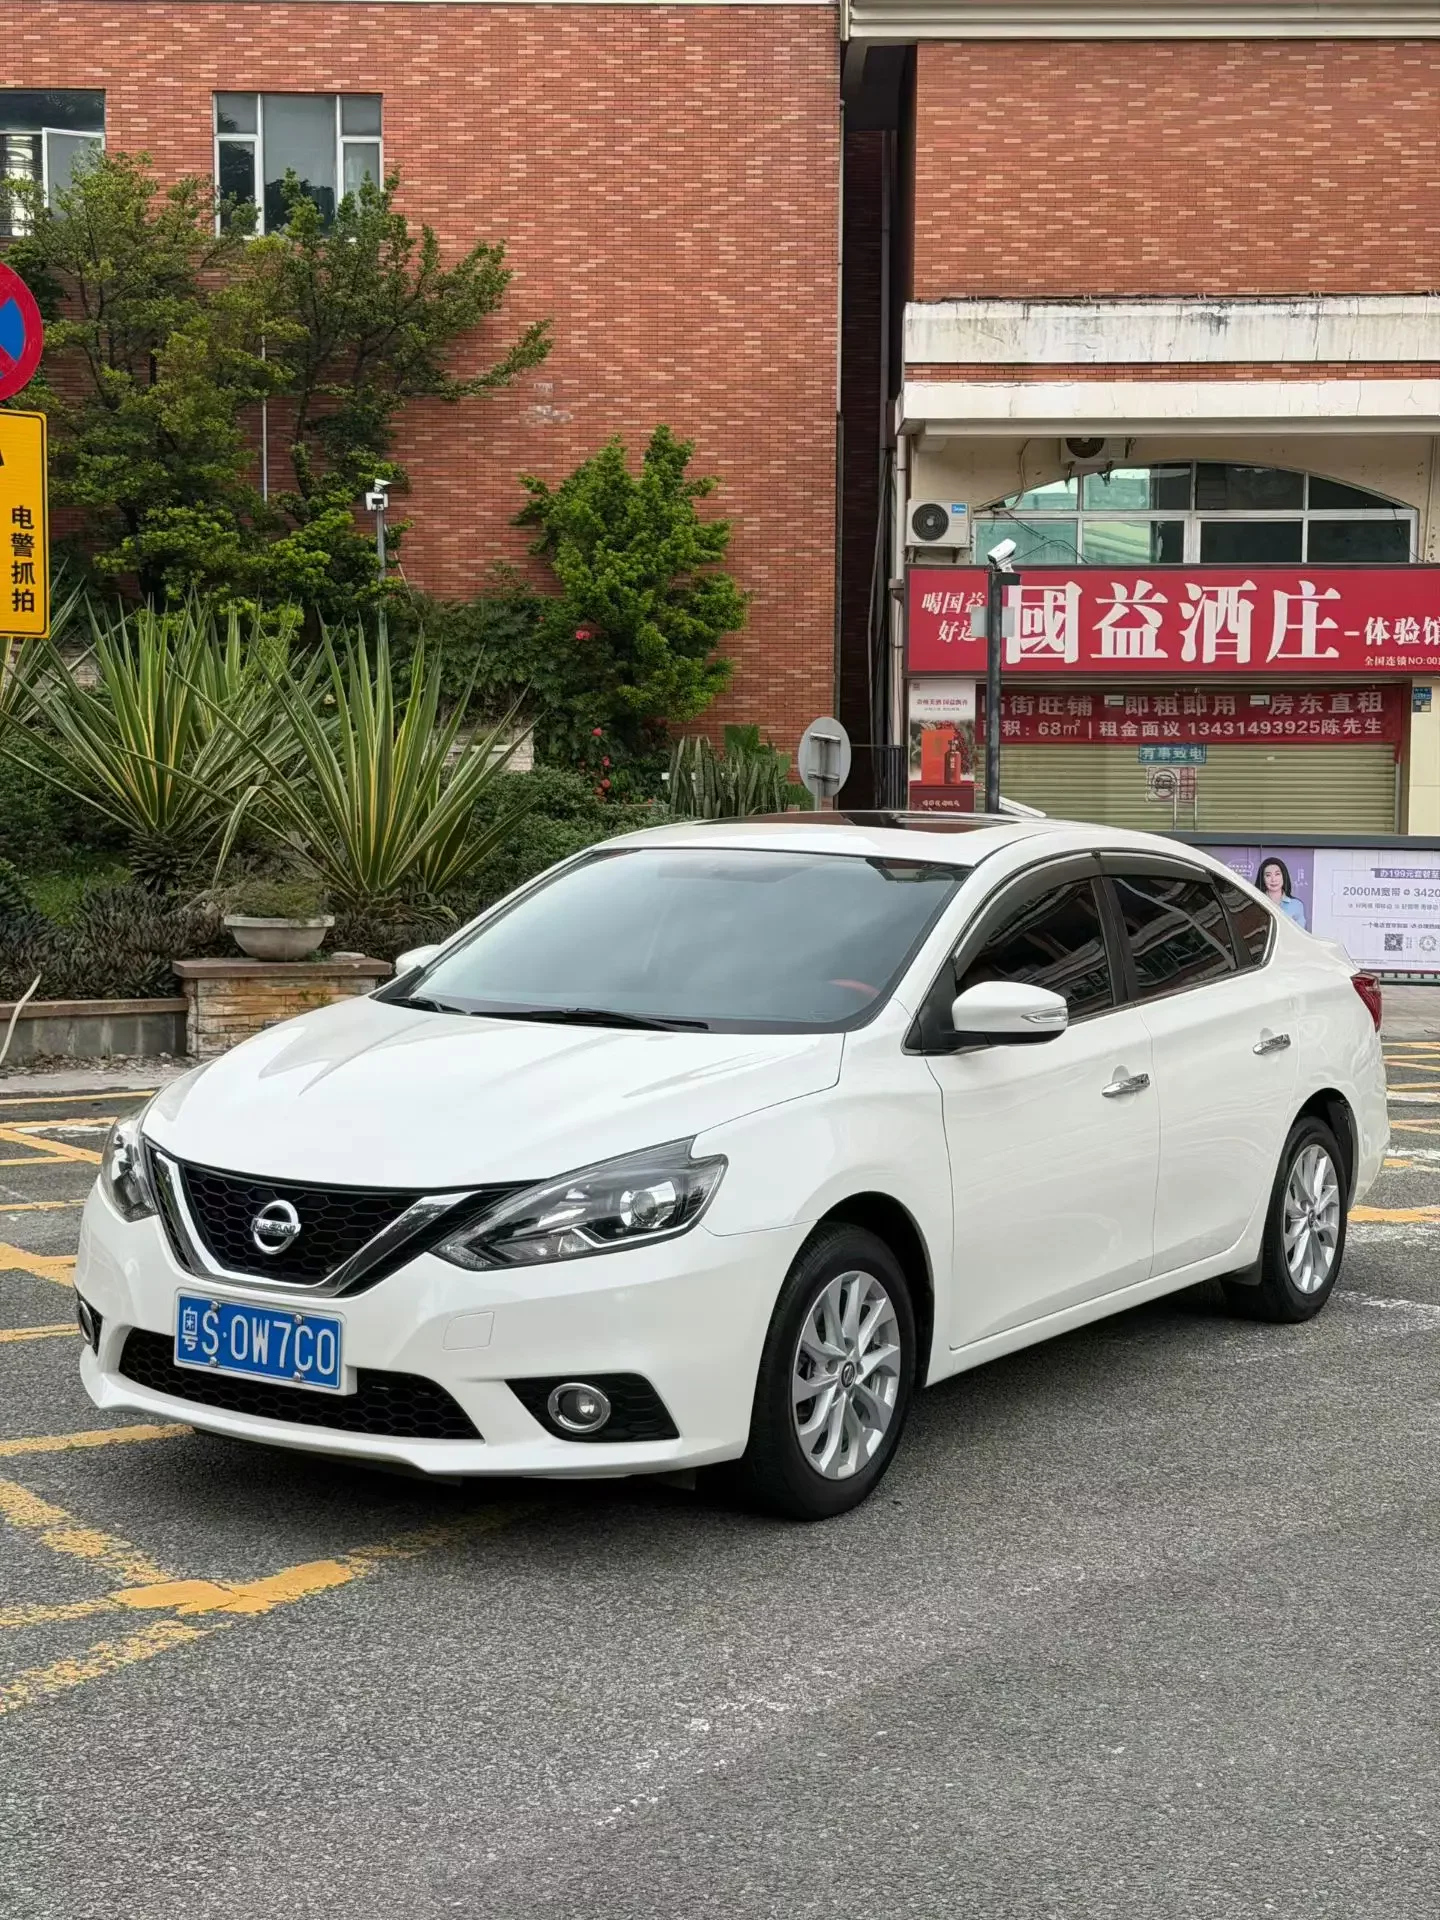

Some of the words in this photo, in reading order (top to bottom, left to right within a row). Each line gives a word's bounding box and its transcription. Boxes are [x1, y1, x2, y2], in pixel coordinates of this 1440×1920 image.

[10, 505, 36, 612] 电警抓拍
[1004, 580, 1342, 664] 國益酒庄
[1100, 720, 1181, 737] 租金面议
[1125, 694, 1236, 716] 即租即用
[1268, 691, 1384, 715] 房东直租
